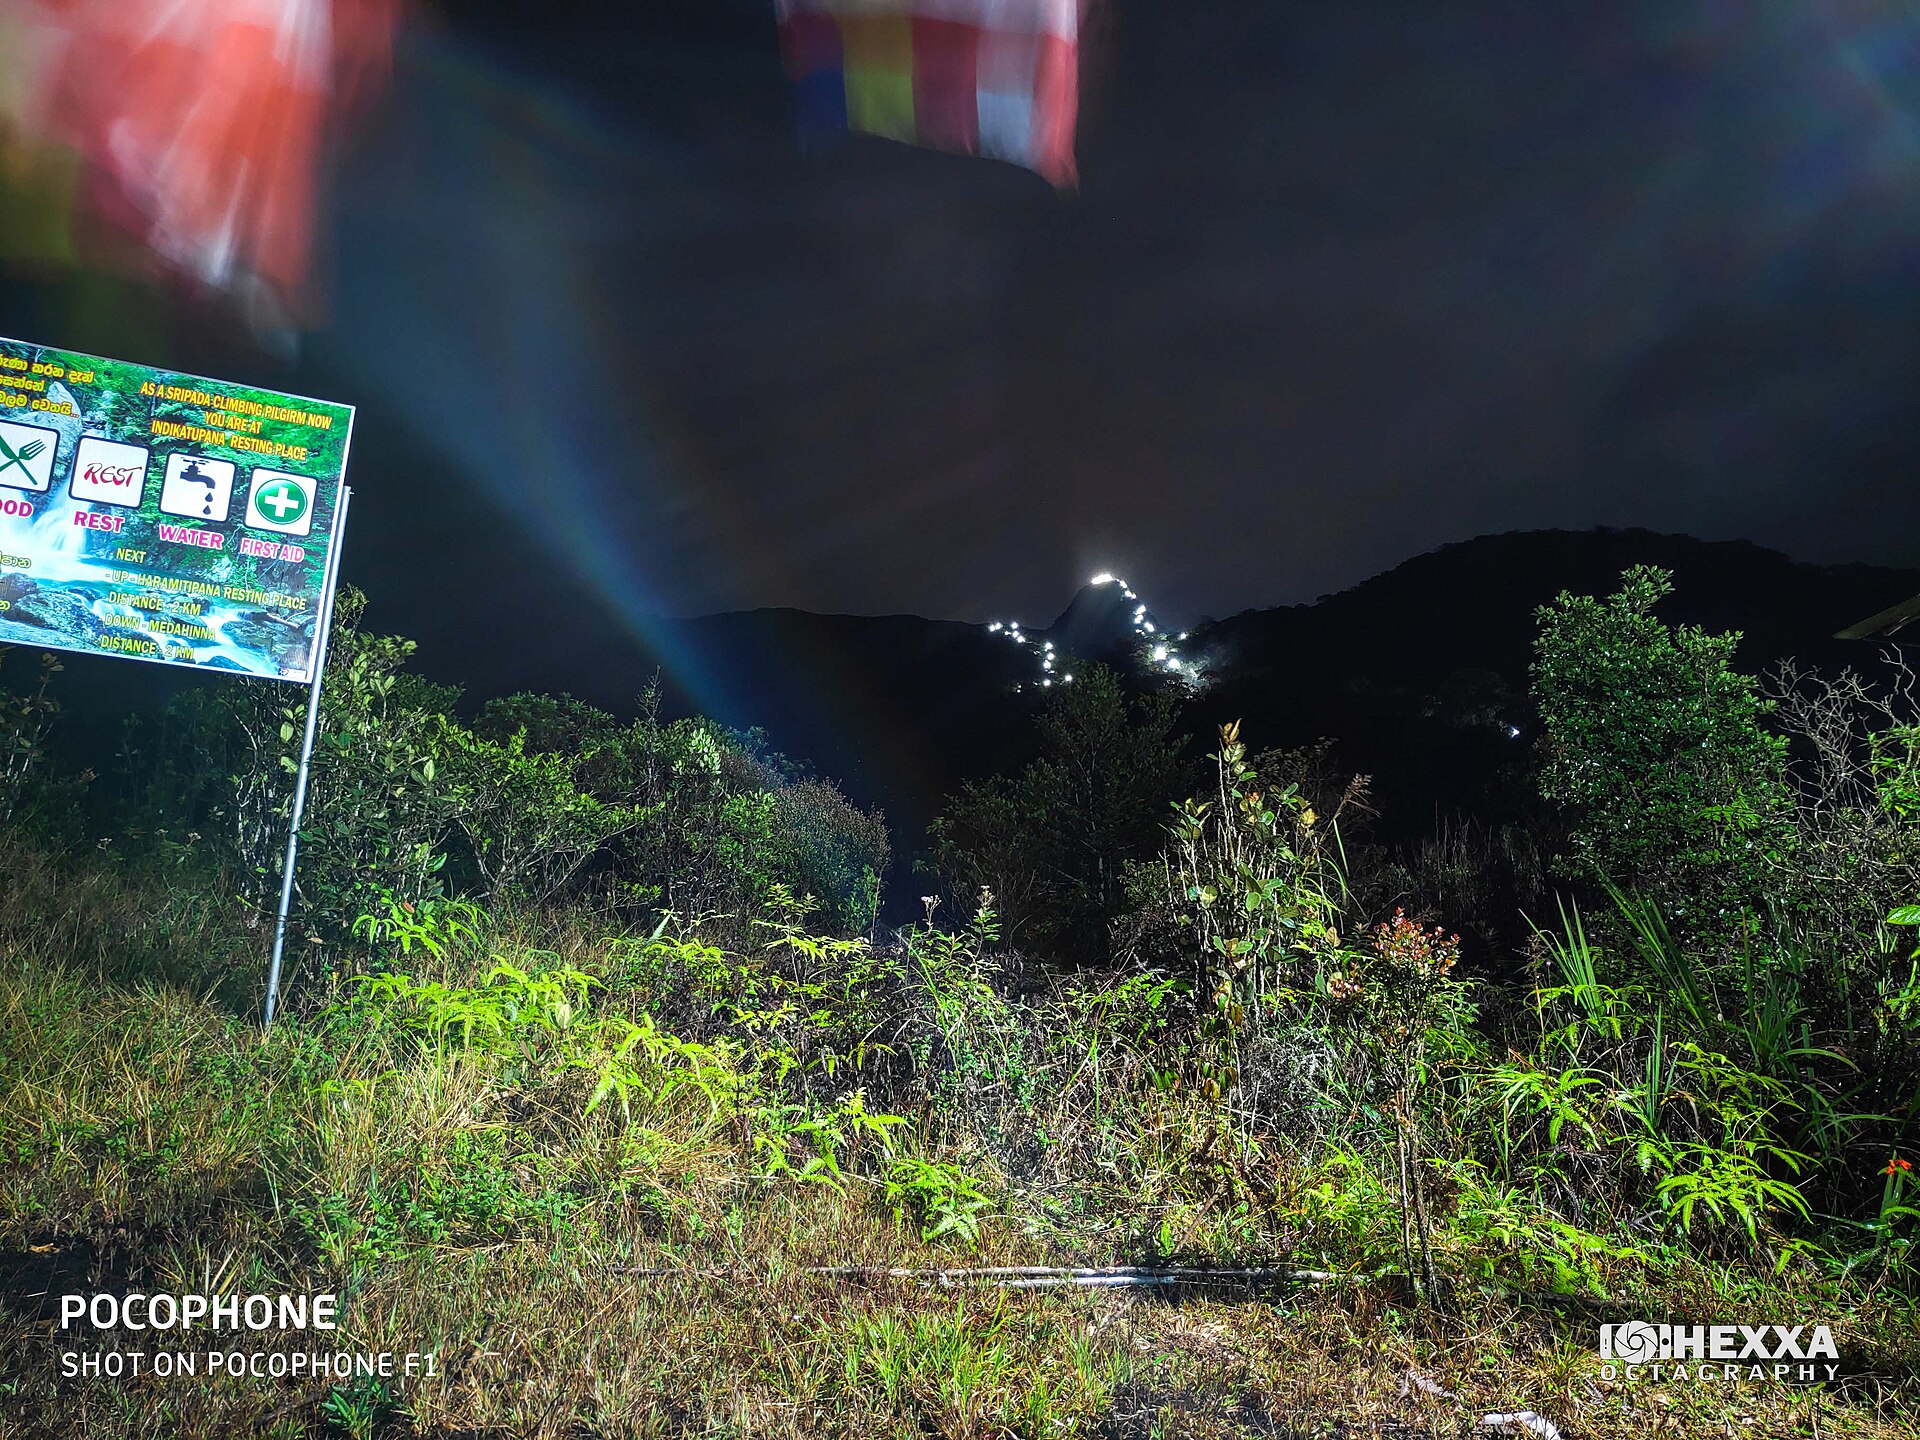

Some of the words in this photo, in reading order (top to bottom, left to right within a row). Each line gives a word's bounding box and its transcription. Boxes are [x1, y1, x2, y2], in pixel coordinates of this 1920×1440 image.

[140, 381, 156, 396] AS
[167, 386, 211, 407] SRIPADA
[213, 395, 263, 416] CLIMBING
[264, 405, 307, 425] PILGIRM
[307, 413, 332, 430] NOW
[205, 411, 226, 428] YOU
[226, 416, 248, 432] ARE
[249, 421, 263, 435] AT
[151, 420, 226, 446] INDIKATUPANA
[230, 435, 273, 454] RESTING
[275, 443, 308, 461] PLACE
[84, 463, 142, 487] REST
[0, 499, 33, 518] OD
[73, 510, 124, 532] REST
[159, 524, 224, 549] WATER
[116, 547, 147, 564] NEXT
[240, 538, 279, 559] FIRST
[280, 546, 305, 562] AID
[112, 569, 129, 583] UP
[137, 573, 221, 597] HARAMITIPANA
[223, 585, 269, 605] RESTING
[271, 595, 307, 611] PLACE
[108, 591, 164, 611] DISTANCE
[171, 601, 179, 613] 2
[182, 602, 202, 616] KM
[104, 612, 140, 629] DOWN
[147, 619, 216, 641] MEDAHINNA
[101, 634, 157, 655] DISTANCE
[164, 644, 173, 657] 2
[175, 645, 194, 660] KM
